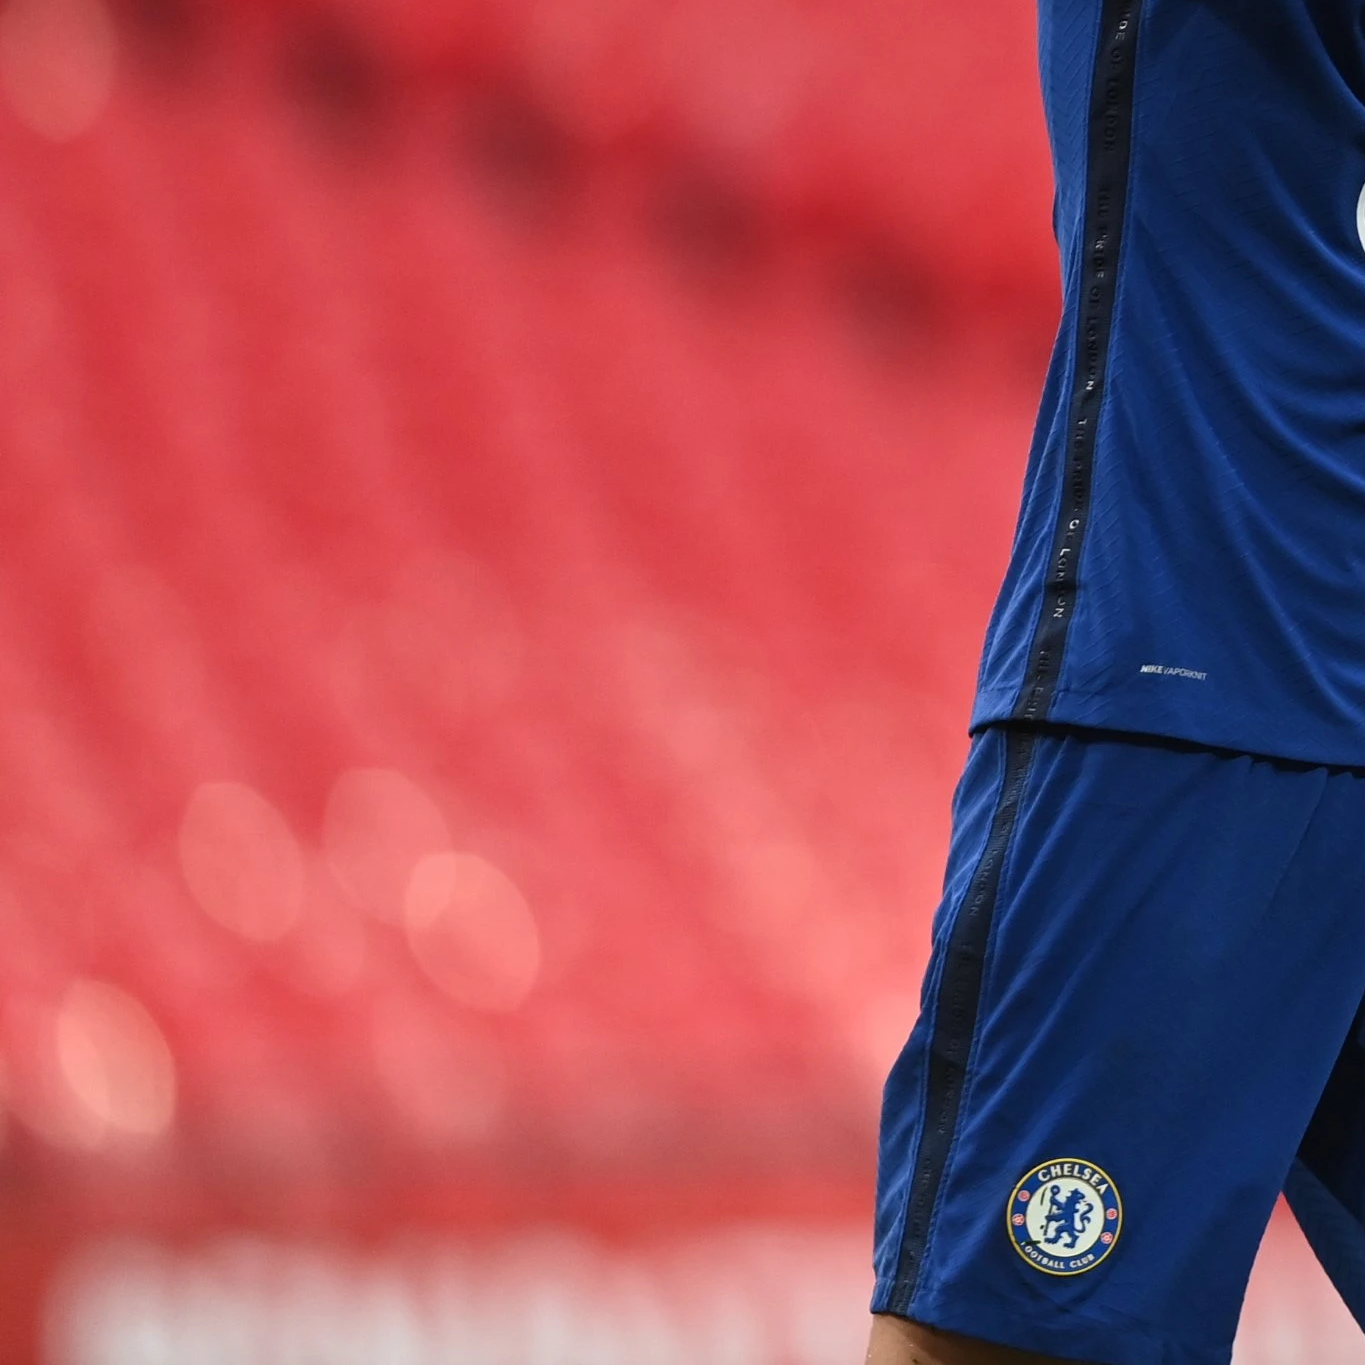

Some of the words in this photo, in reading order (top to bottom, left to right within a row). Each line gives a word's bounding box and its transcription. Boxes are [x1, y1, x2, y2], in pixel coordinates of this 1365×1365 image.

[1052, 547, 1072, 619] LONON
[1140, 665, 1163, 674] NIKE
[1037, 1164, 1109, 1195] CHELSEA
[1021, 1241, 1065, 1269] OOTBALL
[1069, 1253, 1095, 1268] CLUB
